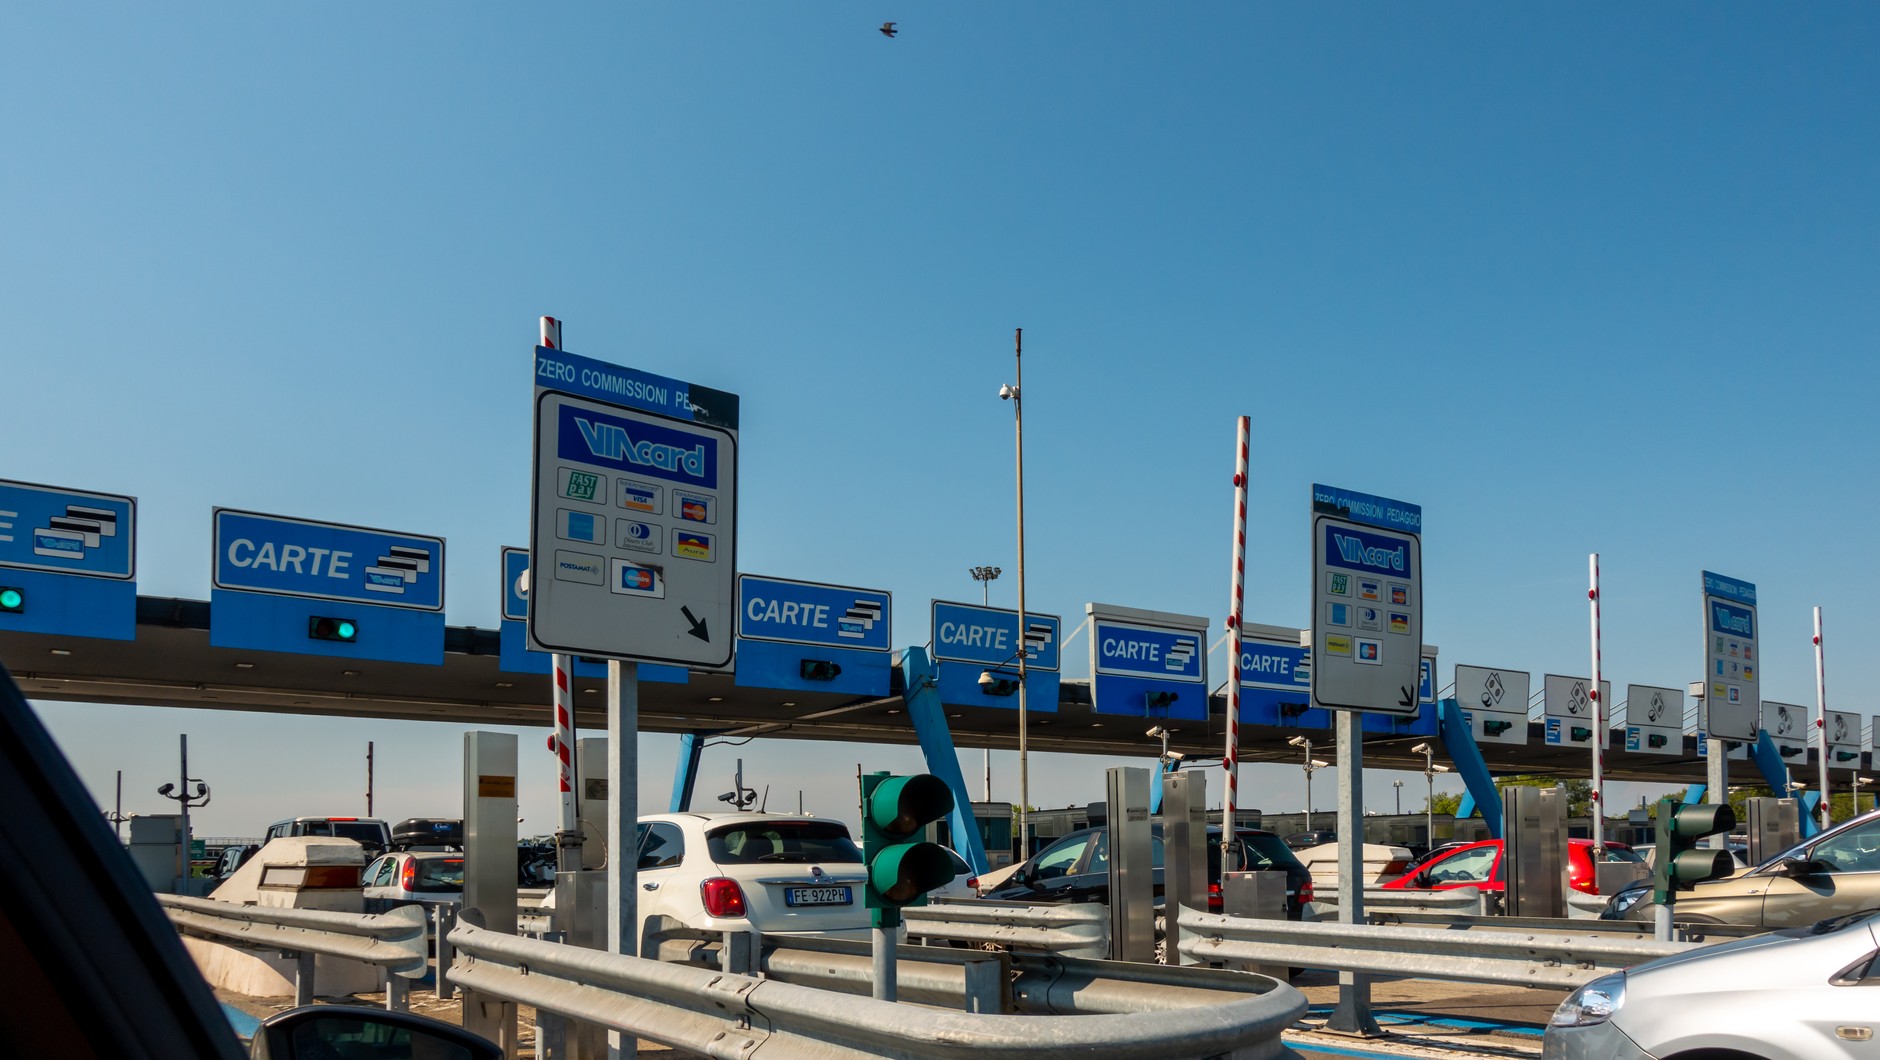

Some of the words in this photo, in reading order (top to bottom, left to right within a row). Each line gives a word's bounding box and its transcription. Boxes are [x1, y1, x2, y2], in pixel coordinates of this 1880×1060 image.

[538, 358, 576, 382] ZERO
[582, 369, 667, 406] COMMISSIONI
[573, 416, 704, 478] VIAcard
[568, 483, 593, 498] pay
[571, 473, 597, 487] FAST
[633, 495, 647, 504] VISA
[1387, 507, 1420, 527] PEDAGGIO
[228, 538, 353, 579] CARTE
[683, 547, 704, 556] Aura
[1333, 533, 1404, 571] VIAcard
[560, 562, 590, 572] POSTAMAT
[747, 597, 830, 628] CARTE
[940, 621, 1009, 650] CARTE
[1103, 638, 1160, 662] CARTE
[1241, 653, 1289, 675] CARTE
[794, 890, 808, 902] FE
[811, 889, 845, 902] 922PH
